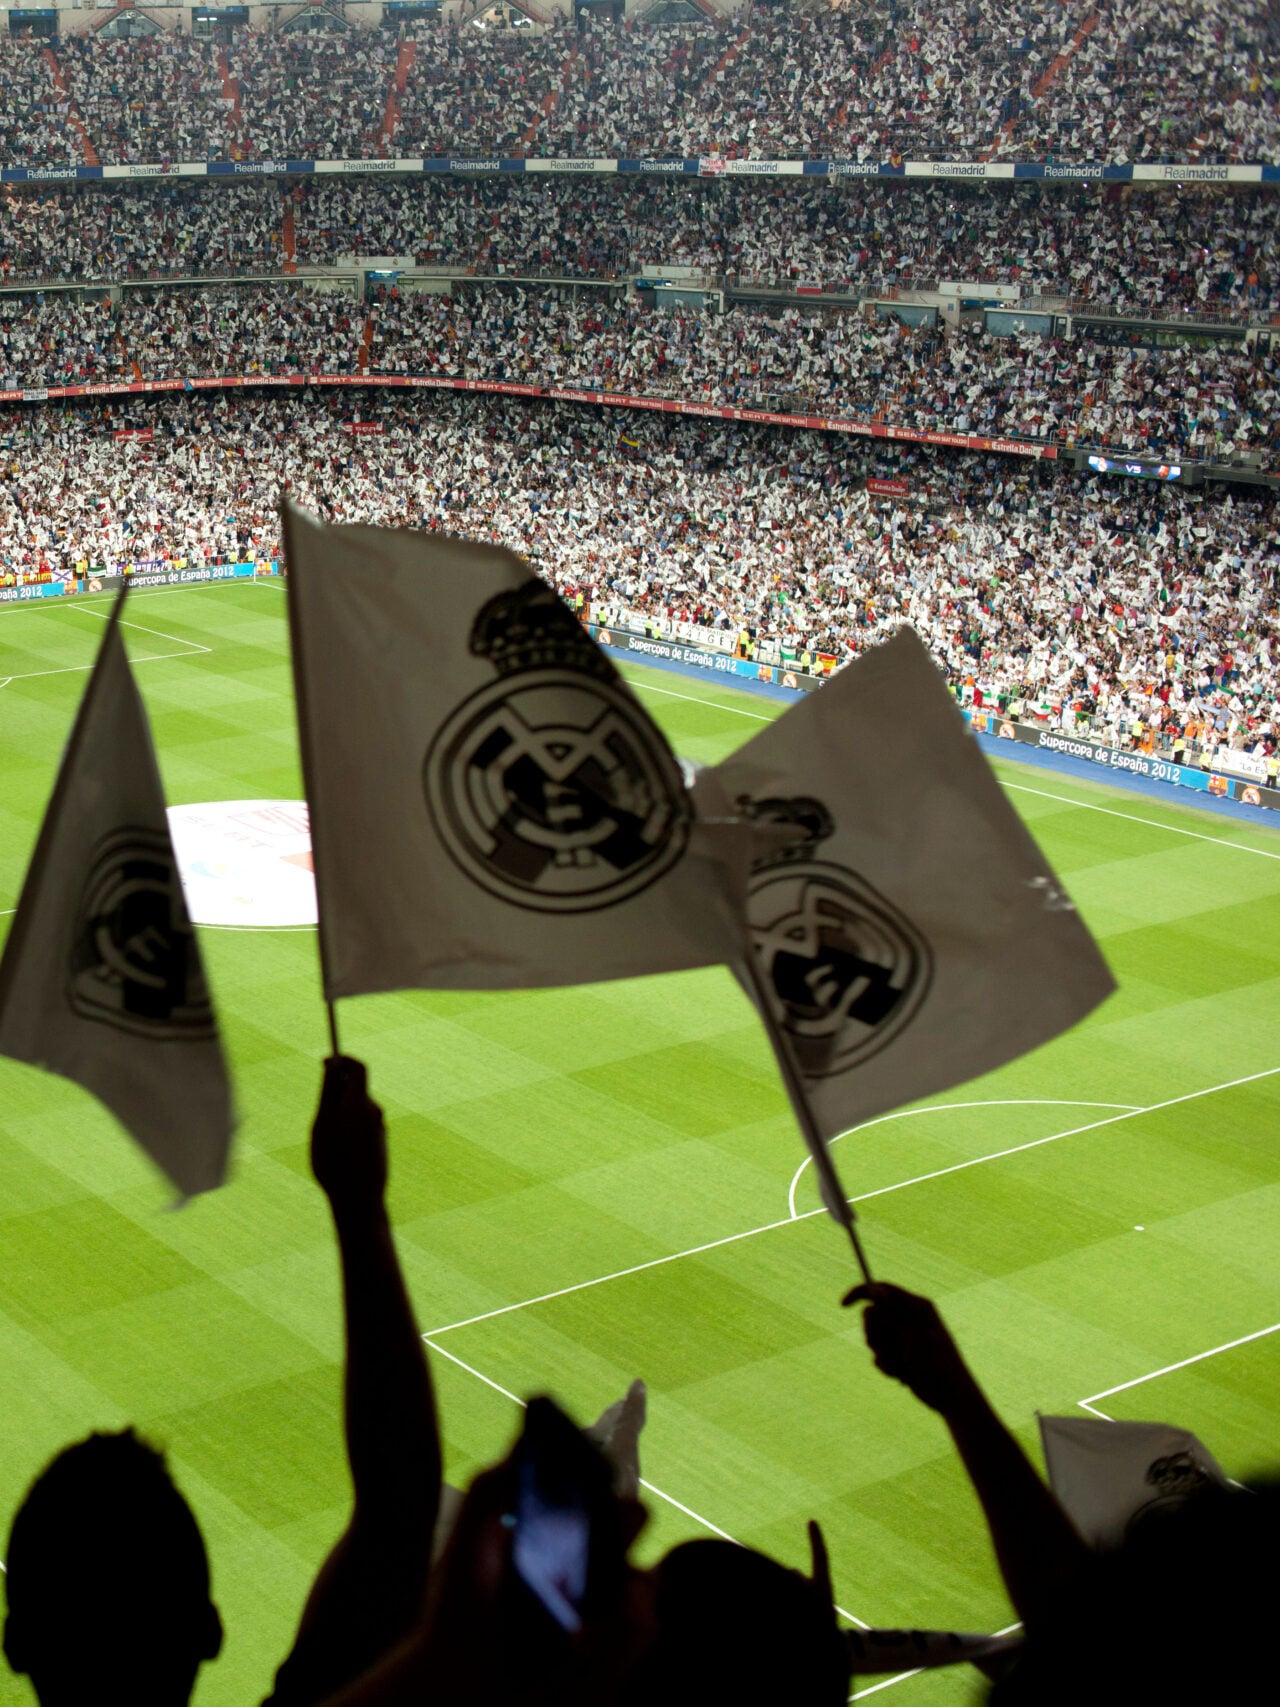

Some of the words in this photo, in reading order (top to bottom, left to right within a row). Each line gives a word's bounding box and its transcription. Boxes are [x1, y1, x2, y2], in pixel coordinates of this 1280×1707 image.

[344, 159, 396, 171] Realmadrid
[450, 160, 500, 171] Realmadrid
[551, 159, 595, 171] Realmadrid
[640, 159, 684, 172] Realmadrid
[731, 160, 778, 173] Realmadrid
[827, 162, 879, 175] Realmadrid
[932, 163, 986, 176] Realmadrid
[26, 168, 77, 180] Realmadrid
[1044, 165, 1102, 178] Realmadrid
[1164, 166, 1229, 180] Realmadrid
[243, 377, 269, 386] Estrella
[411, 378, 435, 387] Estrella
[477, 383, 500, 391] SEAT
[86, 385, 110, 395] Estrella
[550, 389, 571, 400] Estrella
[605, 396, 627, 405] SEAT
[681, 405, 704, 416] Estrella
[827, 422, 852, 433] Estrella
[851, 424, 873, 435] Damm
[991, 441, 1019, 453] Estrella
[1125, 464, 1142, 474] VS
[168, 572, 179, 584] de
[180, 568, 211, 582] España
[213, 564, 235, 577] 2012
[20, 585, 43, 597] 2012
[628, 637, 671, 657] Supercopa
[671, 647, 682, 659] de
[683, 650, 713, 666] España
[715, 656, 737, 672] 2012
[1039, 732, 1093, 758] Supercopa
[1094, 747, 1108, 762] de
[1110, 752, 1149, 773] España
[1151, 762, 1180, 781] 2012
